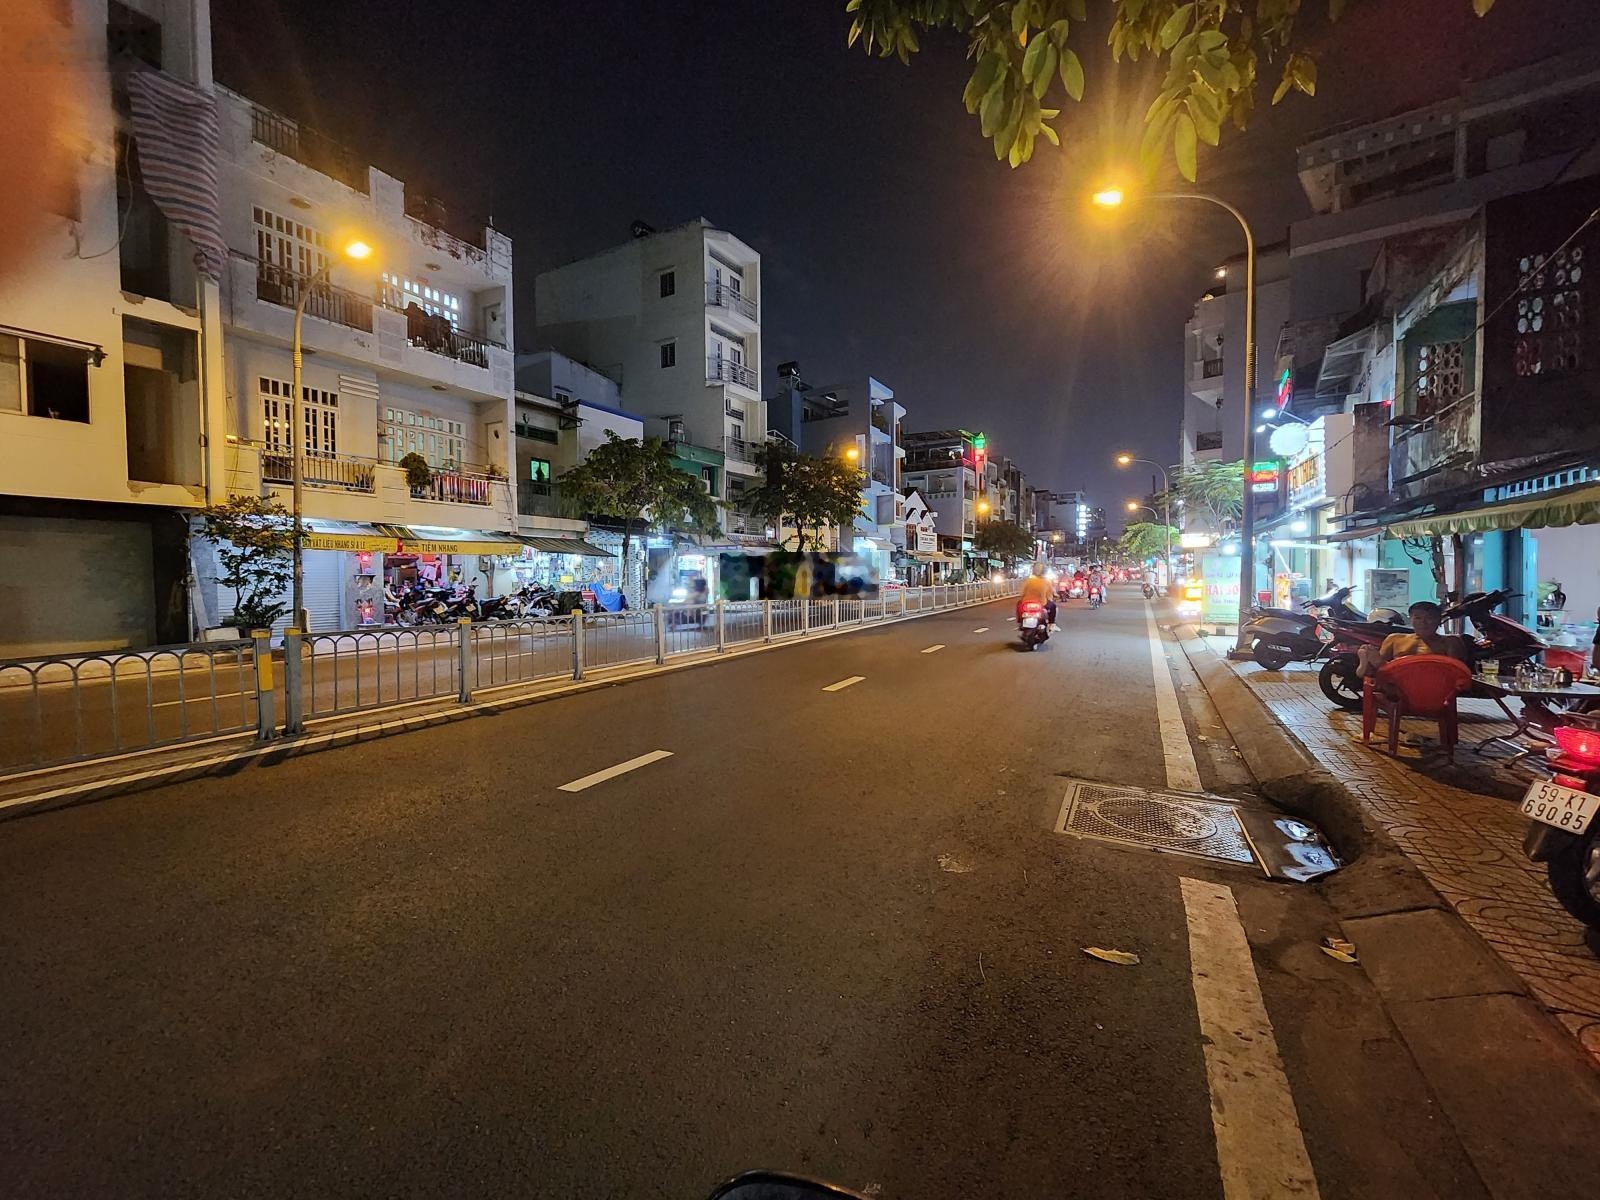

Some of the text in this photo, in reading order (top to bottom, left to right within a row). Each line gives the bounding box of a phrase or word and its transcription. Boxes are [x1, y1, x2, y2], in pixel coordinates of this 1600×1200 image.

[335, 539, 350, 549] NHANG
[439, 543, 458, 553] NHANG
[1524, 799, 1587, 830] 690.85
